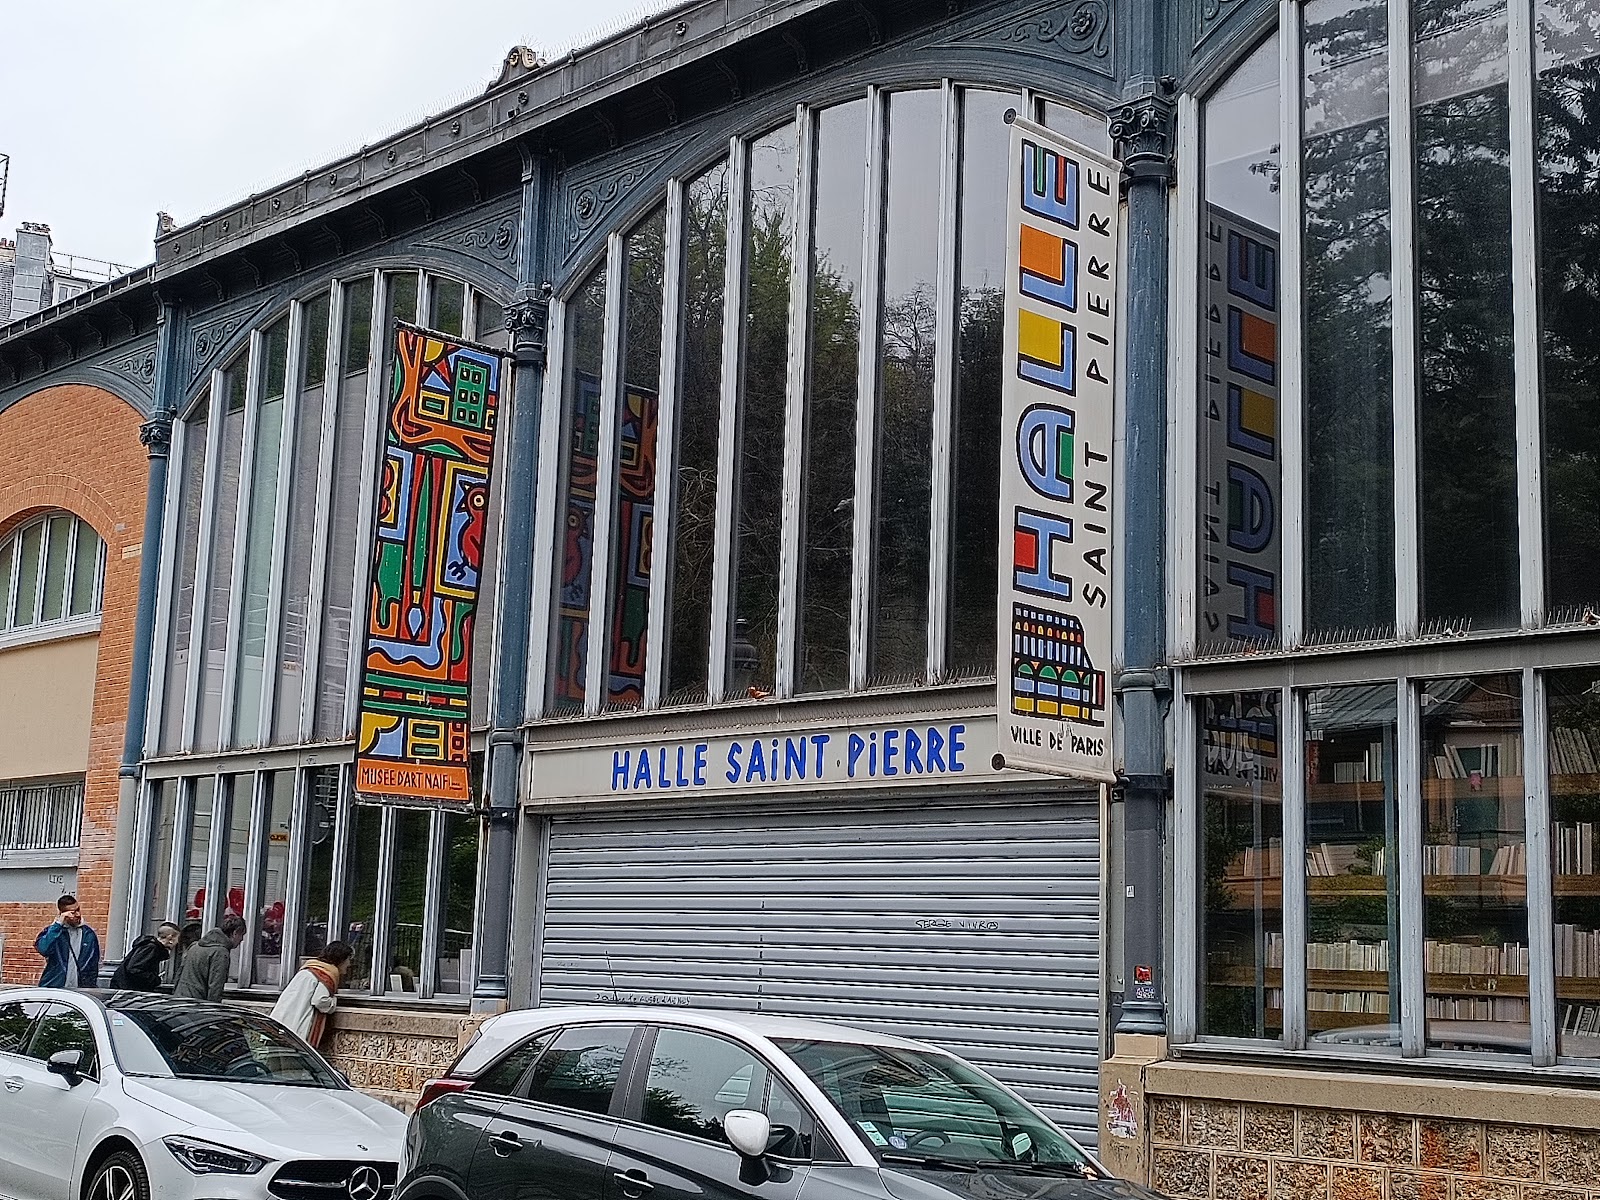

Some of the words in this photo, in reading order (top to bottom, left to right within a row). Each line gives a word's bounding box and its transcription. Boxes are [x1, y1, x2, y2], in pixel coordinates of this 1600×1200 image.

[1086, 167, 1111, 384] PIERRE
[1012, 138, 1080, 602] HALLE
[1082, 441, 1109, 608] SAINT
[397, 770, 423, 789] D'ART
[424, 772, 448, 790] NAIF
[611, 743, 708, 790] HALLE
[1010, 725, 1042, 746] VILLE
[1049, 731, 1063, 751] DE
[1071, 735, 1104, 756] PARIS
